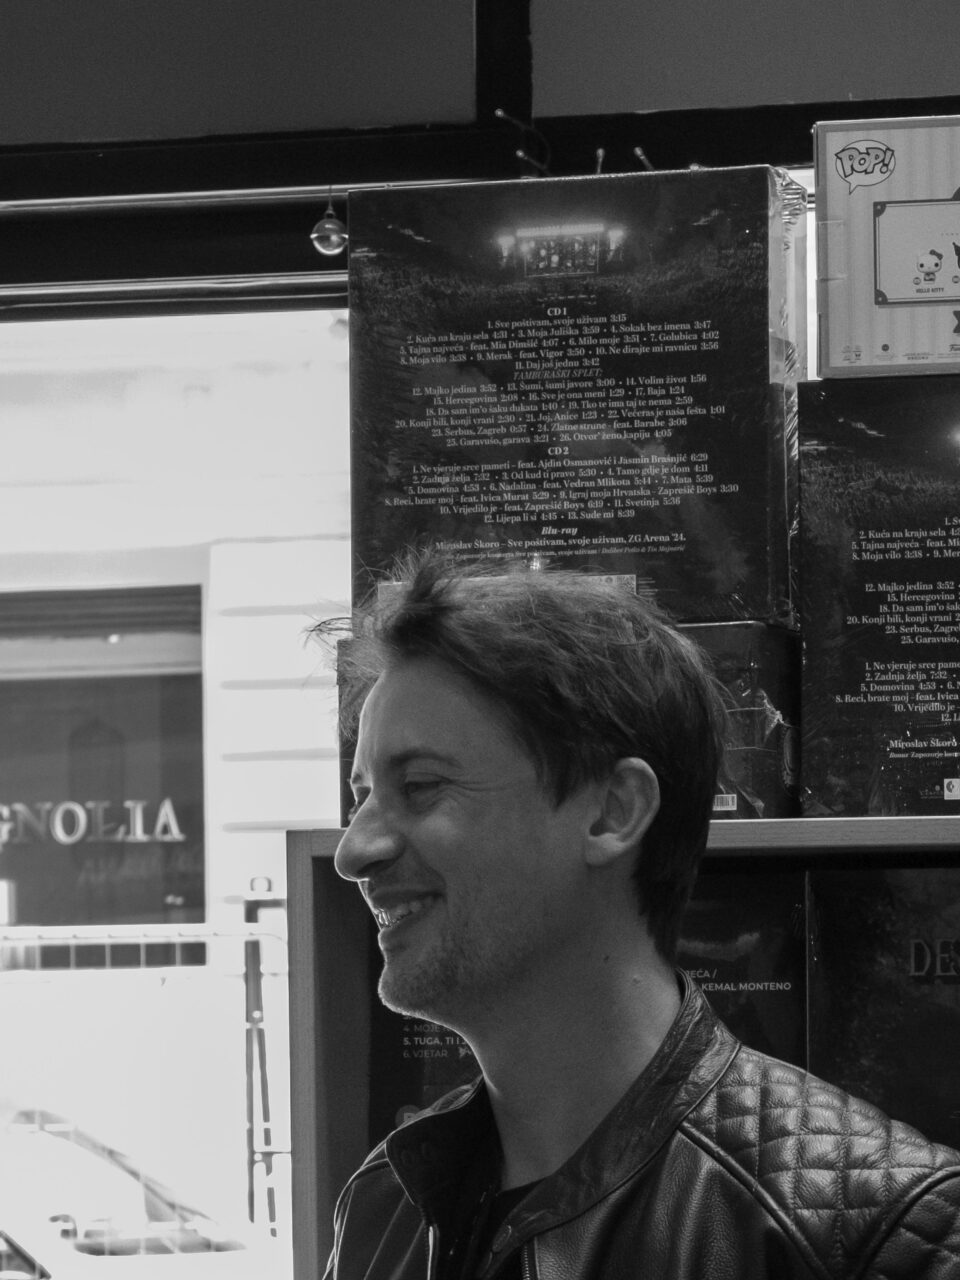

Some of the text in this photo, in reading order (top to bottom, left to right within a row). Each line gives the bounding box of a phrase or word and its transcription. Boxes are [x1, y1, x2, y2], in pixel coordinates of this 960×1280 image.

[835, 147, 896, 178] POP!
[547, 307, 562, 316] CD
[494, 320, 510, 329] Sve
[555, 316, 575, 326] svoje
[576, 315, 607, 324] uživam
[610, 313, 627, 322] 3:15
[609, 346, 621, 355] Ne
[623, 345, 650, 355] dirajte
[651, 344, 663, 352] mi
[664, 343, 698, 352] ravnicu
[700, 341, 719, 350] 3:56
[526, 361, 541, 370] Daj
[541, 360, 554, 370] još
[555, 358, 579, 368] jednu
[582, 358, 600, 367] 3:42
[621, 409, 655, 418] Večeras
[655, 407, 664, 420] je
[665, 407, 685, 416] naša
[686, 406, 707, 416] fešta
[710, 405, 726, 414] 1:01
[548, 447, 569, 455] CD 2
[563, 457, 613, 467] Osmanović
[618, 455, 649, 465] Jasmin
[690, 453, 708, 462] 6:29
[541, 526, 578, 536] Blu-ray
[859, 531, 867, 539] 2.
[868, 530, 891, 539] Kuća
[904, 529, 928, 539] kraju
[929, 528, 946, 537] sela
[474, 539, 500, 549] Škoro
[507, 539, 523, 547] Sve
[568, 536, 590, 546] svoje
[592, 534, 627, 545] uživam,
[628, 534, 642, 542] ZG
[643, 534, 670, 542] Arena
[851, 541, 860, 550] 5.
[861, 541, 885, 551] Tajna
[886, 540, 920, 551] najveća
[926, 539, 946, 547] feat.
[865, 581, 955, 593] 12. Majko jedina 3:52
[887, 591, 955, 602] 15. Hercegovina
[892, 604, 905, 612] Da
[846, 613, 952, 626] 20. Konji bili, konji vrani
[885, 625, 898, 634] 23.
[899, 625, 932, 634] Serbus,
[901, 634, 960, 644] 25. Garavušo,
[889, 738, 958, 749] Miroslav Škoro
[701, 982, 792, 991] KEMAL MONTENO
[403, 1038, 411, 1046] 5.
[414, 1037, 443, 1046] TUGA,
[445, 1037, 454, 1045] TI
[413, 1049, 449, 1058] VJETAR
